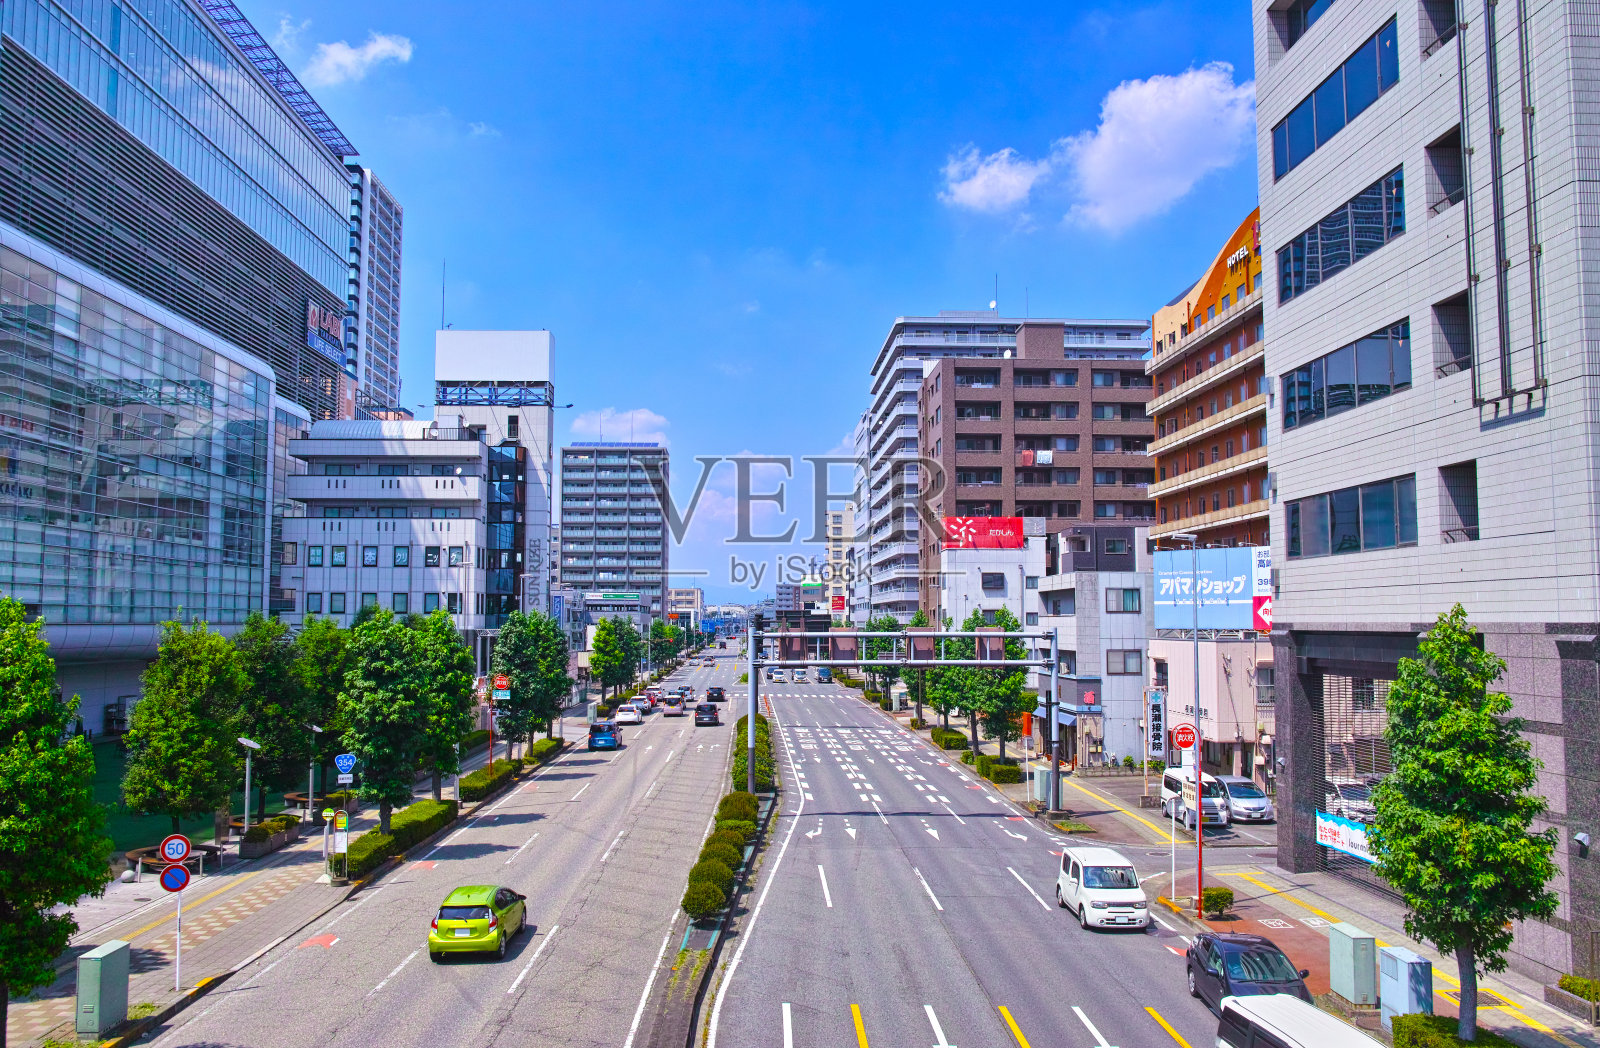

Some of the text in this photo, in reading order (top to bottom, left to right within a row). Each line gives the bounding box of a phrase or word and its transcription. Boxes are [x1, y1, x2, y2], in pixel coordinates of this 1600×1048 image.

[1227, 245, 1249, 268] HOTEL
[321, 306, 341, 340] LABI
[314, 336, 342, 362] LIFE SELECT
[1160, 574, 1246, 595] アパマンショップ
[1152, 703, 1163, 751] 長瀬接骨院
[1177, 733, 1194, 742] 消火栓
[338, 759, 353, 767] 354
[167, 843, 184, 855] 50
